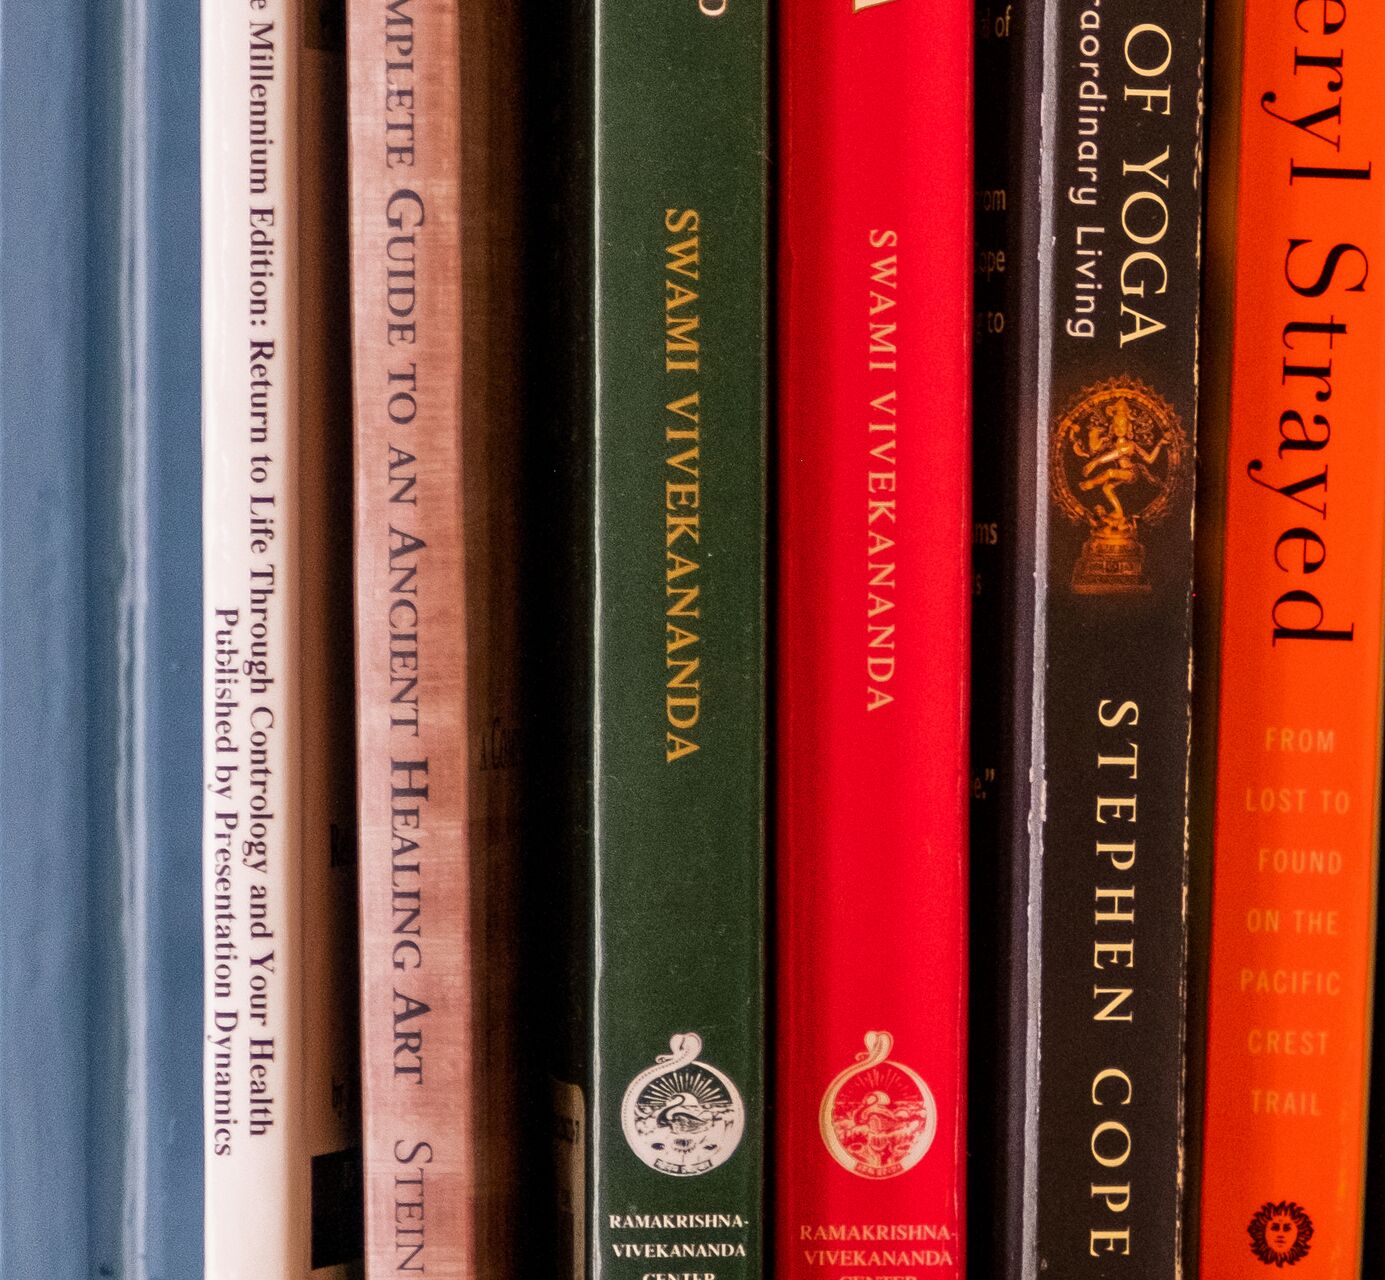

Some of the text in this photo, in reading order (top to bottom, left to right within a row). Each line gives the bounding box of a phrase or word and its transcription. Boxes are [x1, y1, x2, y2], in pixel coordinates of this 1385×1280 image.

[996, 5, 1012, 37] of
[1124, 24, 1172, 115] OF
[250, 23, 274, 193] Millennium
[251, 208, 274, 325] Edition:
[1120, 146, 1169, 348] YOGA
[1066, 227, 1105, 337] Living
[988, 312, 1005, 333] to
[251, 341, 275, 442] Return
[251, 456, 272, 483] to
[867, 230, 897, 711] SWAMI VIVEKANANDA
[1247, 239, 1367, 646] Strayed
[666, 209, 699, 763] SWAMI VIVEKANANDA
[251, 497, 275, 553] Life
[245, 564, 274, 693] Through
[1266, 727, 1335, 753] FROM
[243, 707, 274, 873] Contrology
[1247, 789, 1349, 814] LOST TO
[208, 609, 239, 1156] Published by Presentation Dynamics
[1259, 850, 1342, 875] FOUND
[250, 885, 273, 938] and
[1247, 910, 1337, 934] ON THE
[250, 951, 274, 1026] Your
[1090, 700, 1139, 1256] STEPHEN COPE
[1240, 971, 1340, 995] PACIFIC
[1247, 1031, 1329, 1055] CREST
[250, 1040, 274, 1135] Health
[1252, 1089, 1321, 1116] TRAIL
[609, 1215, 749, 1229] RAMAKRISHNA-
[800, 1225, 957, 1240] RAMAKRISHNA-
[613, 1244, 745, 1257] VIVEKANANDA
[805, 1251, 952, 1266] VIVEKANANDA
